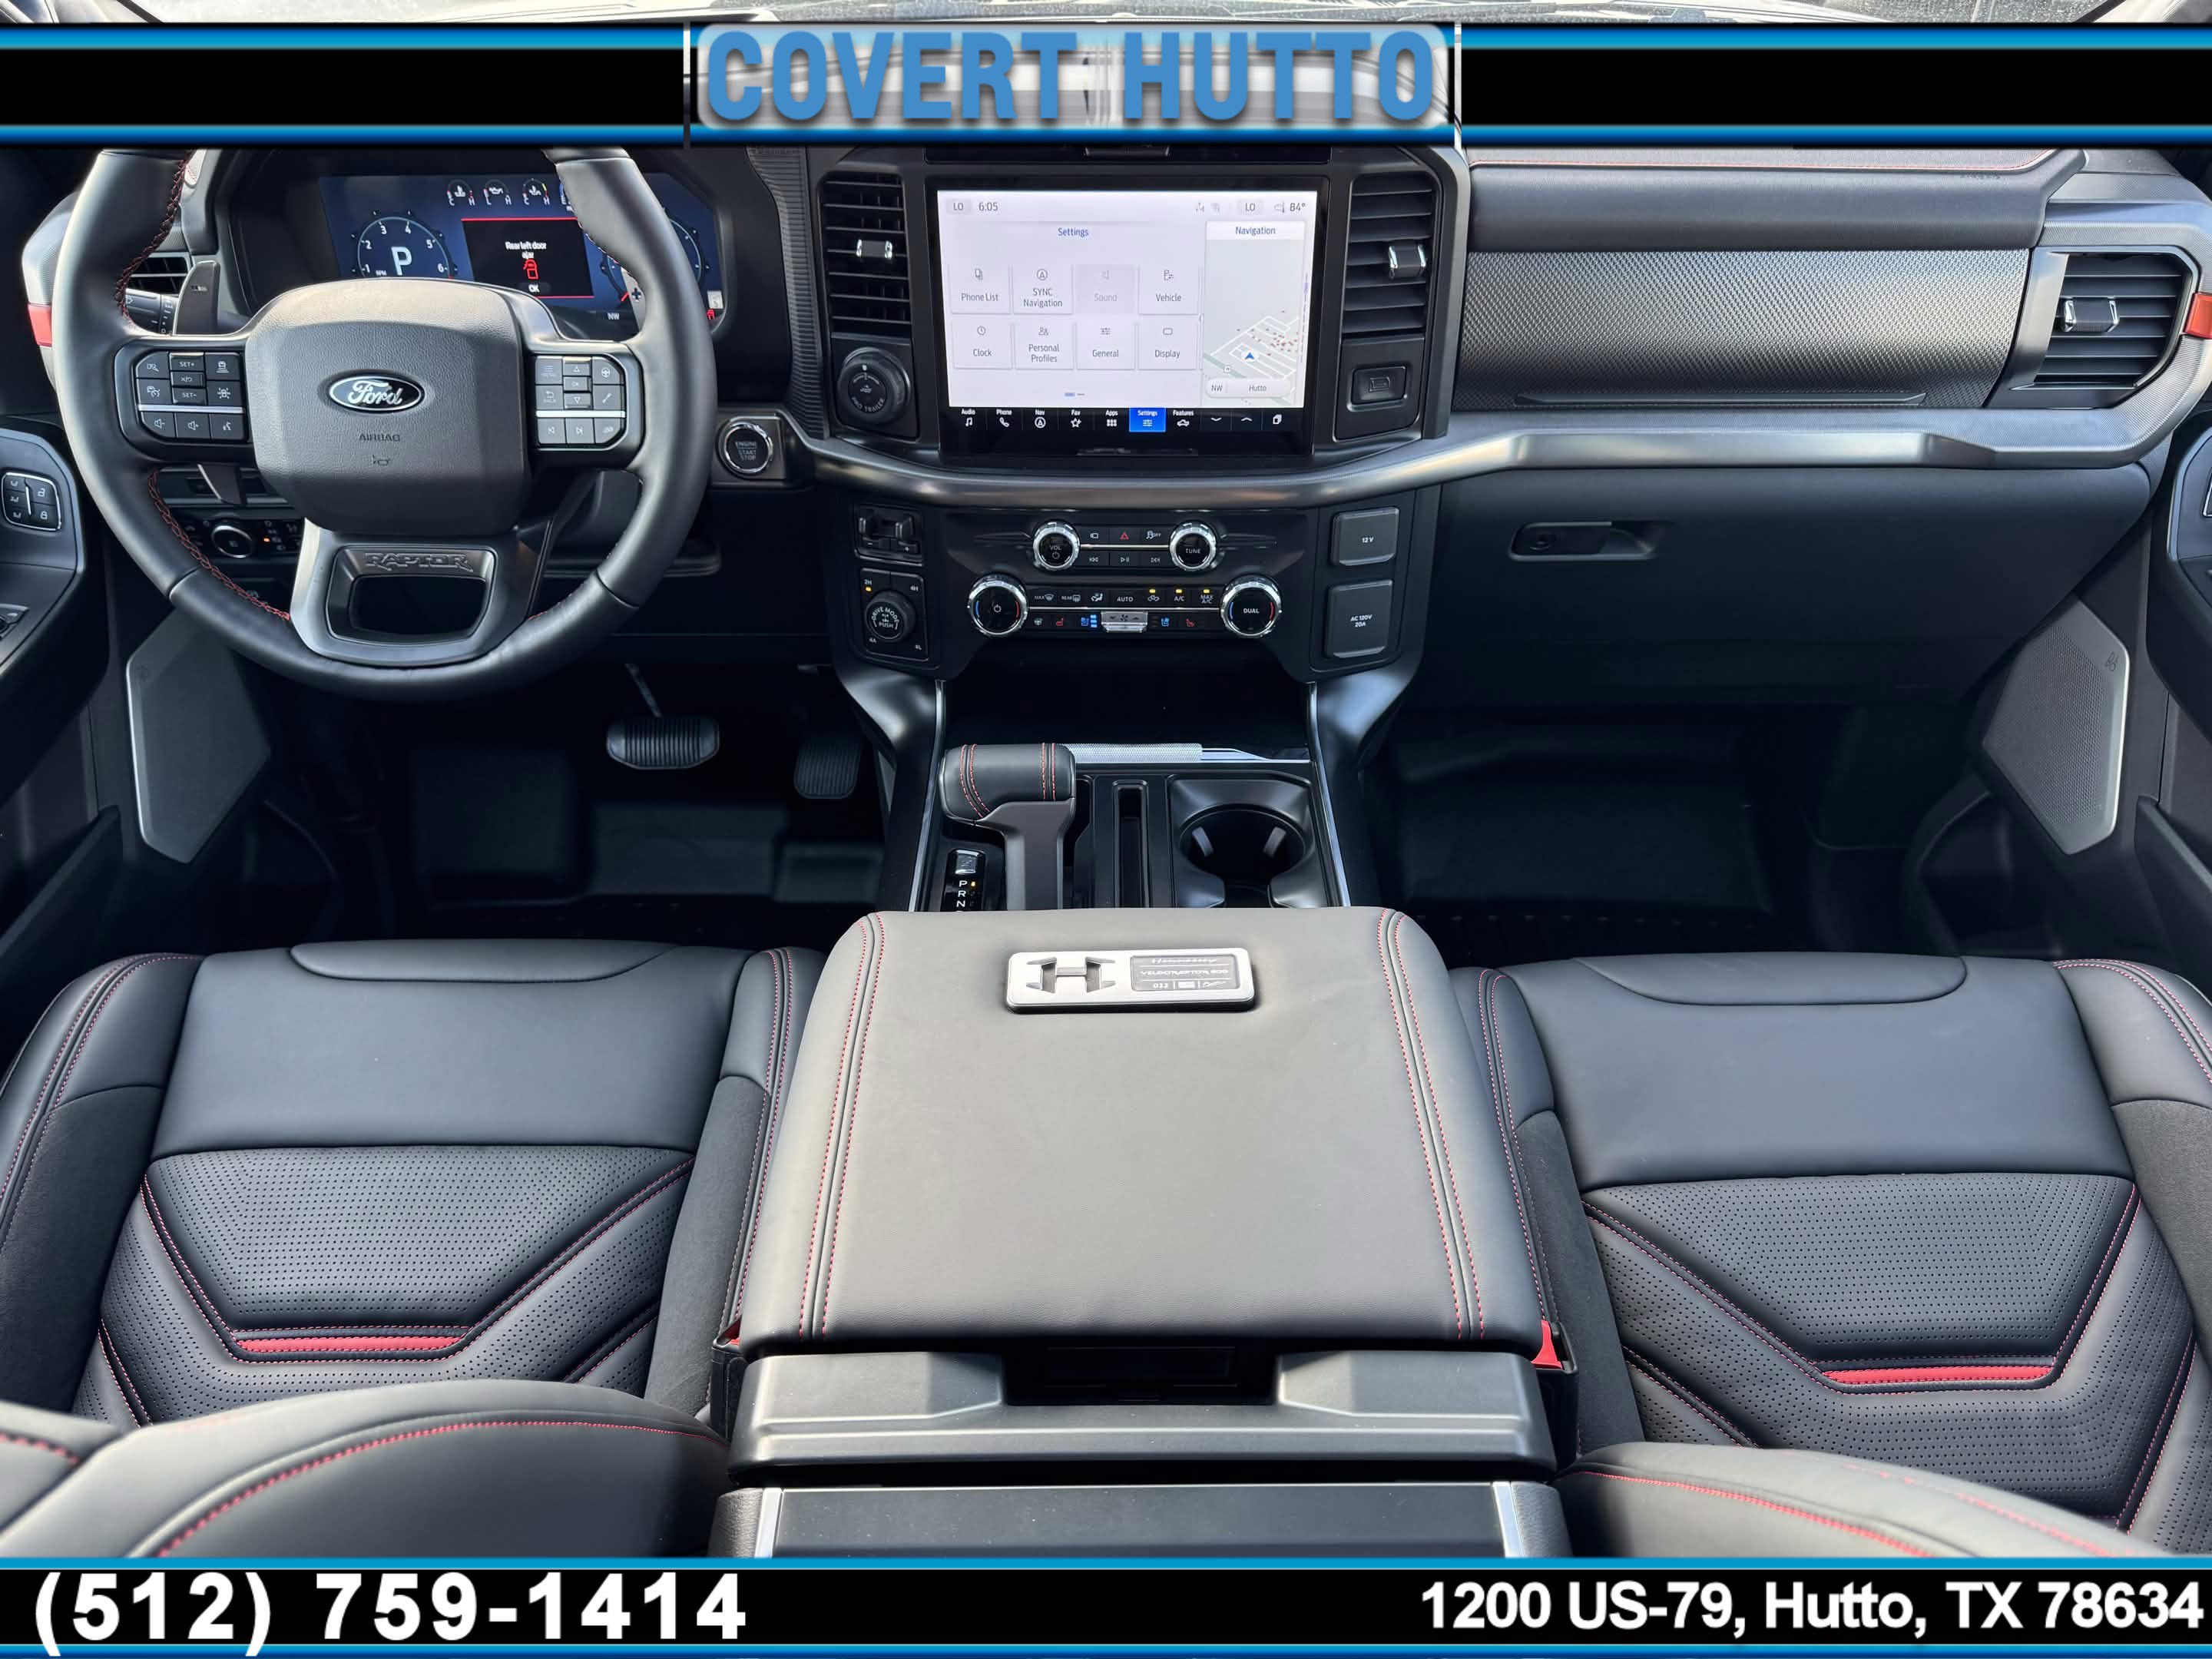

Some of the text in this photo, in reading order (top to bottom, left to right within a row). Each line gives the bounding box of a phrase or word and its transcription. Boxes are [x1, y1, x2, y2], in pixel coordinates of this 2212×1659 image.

[979, 202, 998, 211] 6:05
[1245, 203, 1256, 211] LO
[380, 226, 387, 234] 3
[405, 225, 411, 234] 4
[1058, 227, 1089, 237] Settings
[1235, 227, 1276, 236] Navigation
[366, 240, 373, 249] 2
[426, 240, 433, 249] 5
[505, 241, 547, 250] Rear left door
[390, 246, 412, 276] P
[437, 263, 445, 273] 6
[528, 284, 540, 293] OK
[1032, 288, 1053, 296] SYNC
[961, 293, 998, 302] Phone List
[1094, 293, 1118, 302] Sound
[1155, 293, 1182, 302] Vehicle
[1023, 299, 1063, 308] Navigation
[1028, 343, 1060, 352] Personal
[973, 349, 992, 357] Clock
[1092, 349, 1119, 358] General
[1154, 349, 1181, 359] Display
[1031, 354, 1058, 363] Profiles
[348, 379, 403, 406] Ford
[358, 432, 401, 442] AIRBAG
[363, 551, 474, 573] RAPTOR
[959, 879, 969, 888] P
